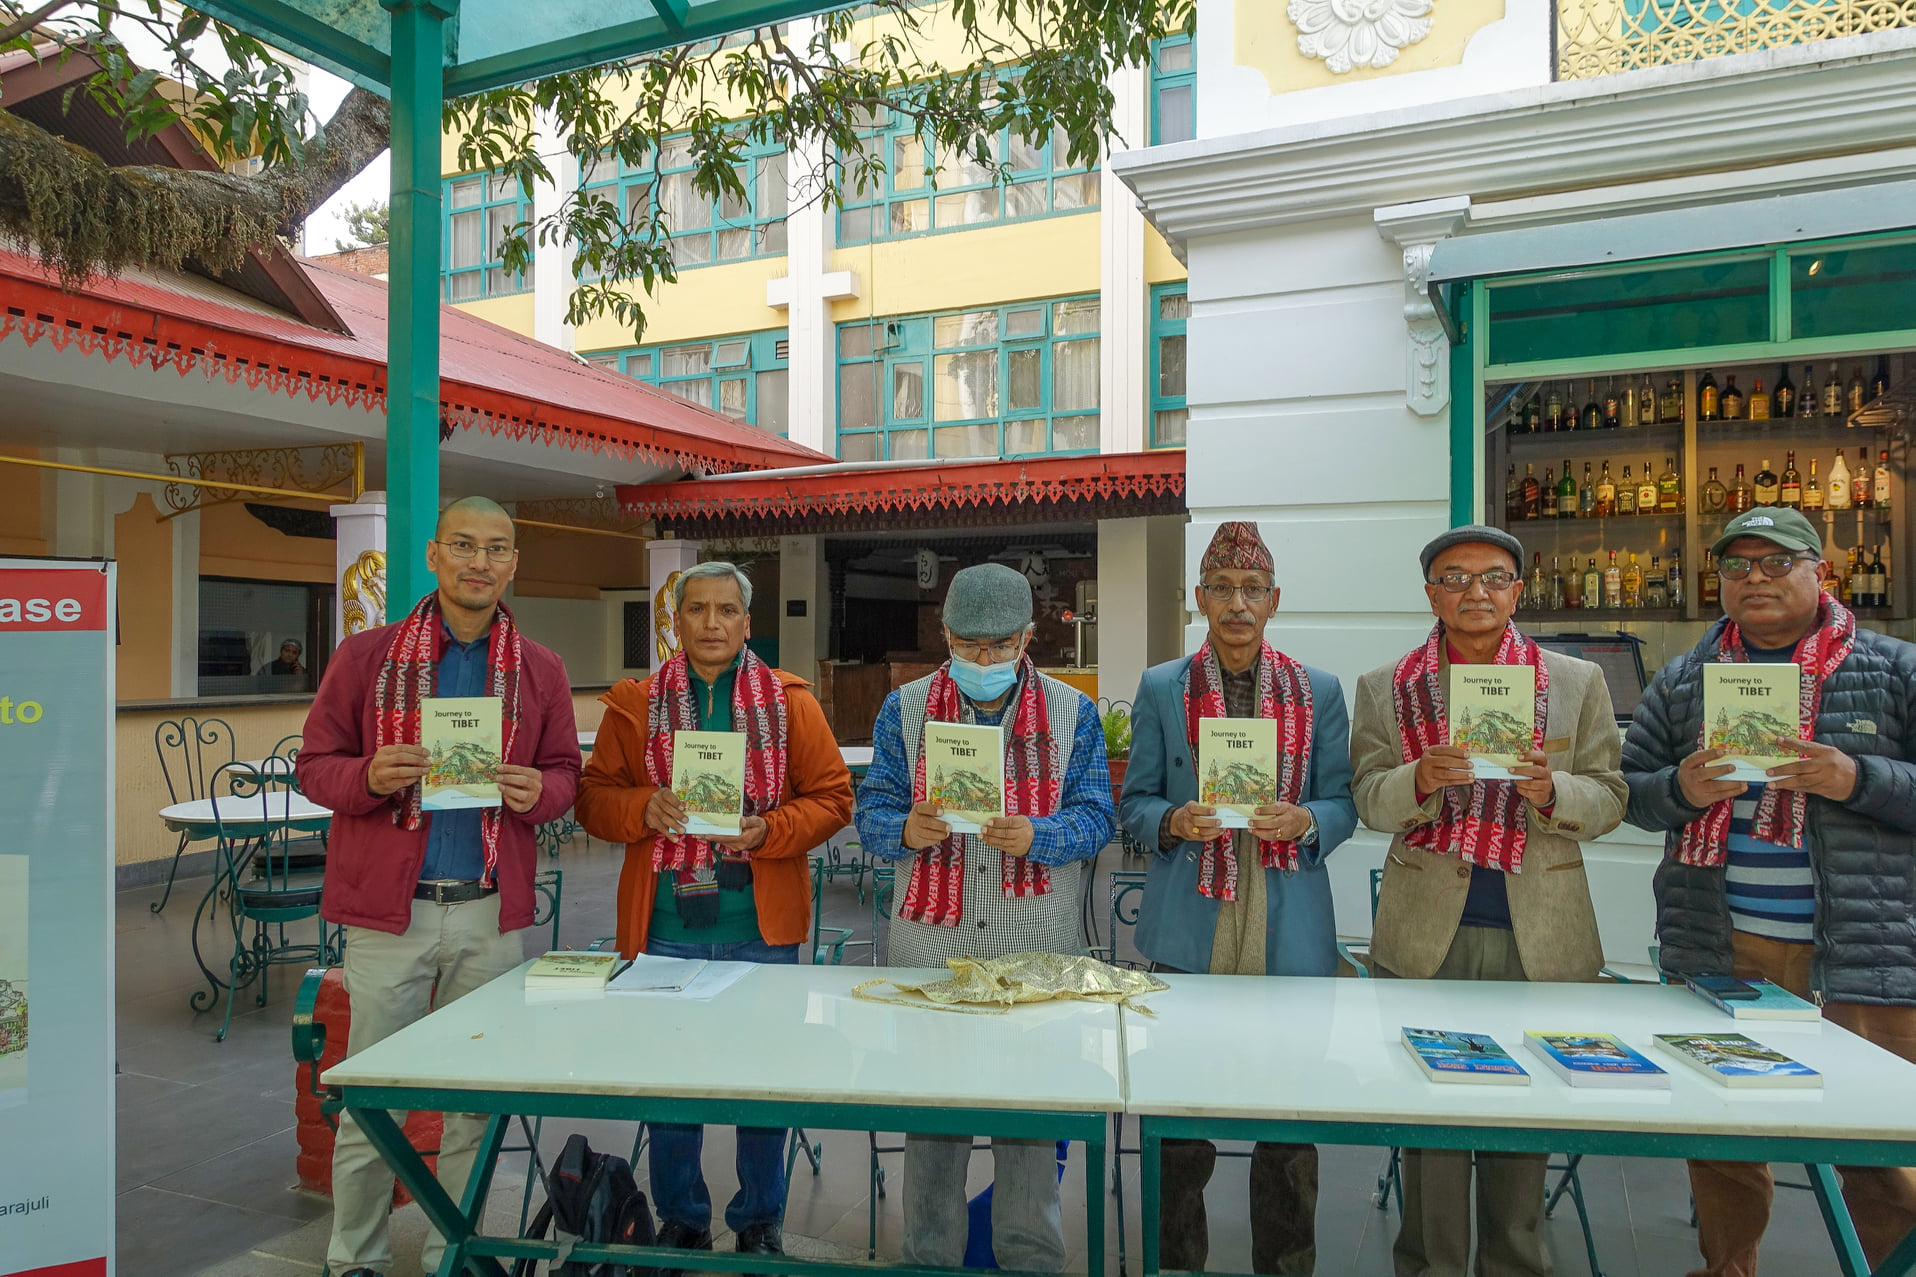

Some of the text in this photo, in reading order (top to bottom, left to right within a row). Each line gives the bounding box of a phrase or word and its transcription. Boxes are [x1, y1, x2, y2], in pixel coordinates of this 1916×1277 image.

[0, 598, 82, 623] ase
[396, 661, 410, 701] NEPAL
[750, 677, 765, 707] NEPAL
[1463, 676, 1493, 685] Journey
[1480, 686, 1511, 696] TIBET
[1719, 676, 1752, 685] Journey
[1738, 686, 1772, 696] TIBET
[0, 696, 43, 724] to
[434, 710, 463, 718] Journey
[648, 697, 659, 727] NEPAL
[679, 689, 690, 723] NEPAL
[1026, 690, 1037, 725] NEPAL
[1429, 683, 1445, 720] NEPAL
[1800, 684, 1815, 726] NEPAL
[451, 719, 480, 728] TIBET
[758, 717, 772, 750] NEPAL
[779, 712, 787, 749] NEPAL
[1210, 730, 1238, 739] Journey
[1284, 713, 1296, 752] NEPAL
[684, 742, 709, 751] Journey
[935, 736, 961, 746] Journey
[950, 747, 977, 757] TIBET
[1025, 732, 1038, 769] NEPAL
[1226, 740, 1254, 749] TIBET
[1301, 720, 1312, 758] NEPAL
[698, 751, 723, 760] TIBET
[764, 759, 776, 798] NEPAL
[913, 769, 926, 802] NEPA
[1472, 780, 1486, 809] NEPA
[1497, 780, 1511, 813] NEPA
[0, 1196, 49, 1216] arajuli
